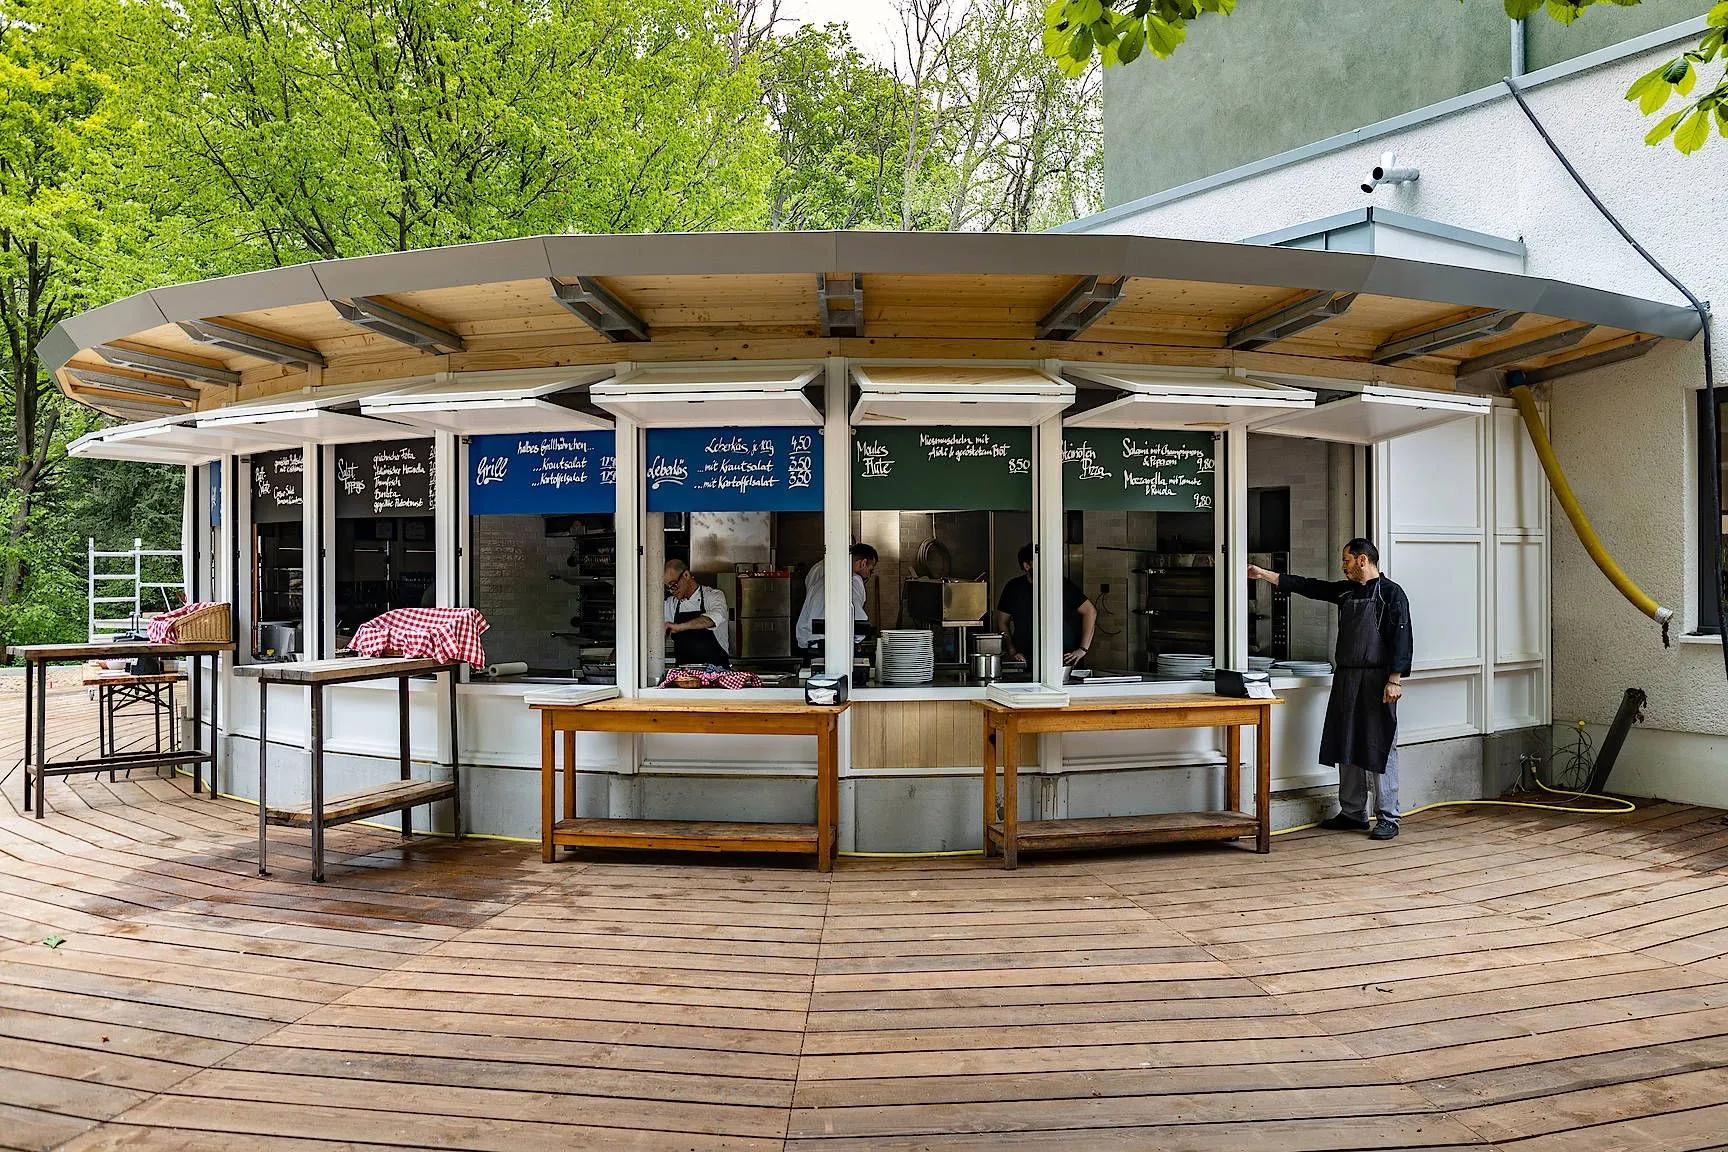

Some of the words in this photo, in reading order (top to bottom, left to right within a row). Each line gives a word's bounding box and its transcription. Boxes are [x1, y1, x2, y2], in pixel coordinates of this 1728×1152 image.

[518, 440, 539, 455] halbes
[760, 439, 775, 456] 100g
[919, 433, 974, 448] Miesmuscheln
[975, 433, 990, 445] mit
[1122, 437, 1149, 458] Salami
[1150, 444, 1161, 455] mit
[1161, 444, 1204, 460] Champignons
[856, 439, 889, 462] Moules
[992, 443, 1011, 458] Brot
[646, 455, 689, 481] Leberkäs
[719, 458, 774, 474] Krautsalat
[1008, 458, 1031, 473] 8,50
[1079, 458, 1112, 480] Pizza
[1142, 455, 1150, 467] &
[1196, 457, 1215, 473] 9,80
[477, 456, 509, 485] Grill
[718, 474, 780, 494] Kartoffelsalat
[1123, 469, 1168, 490] Mozzarella
[1168, 475, 1178, 485] mit
[1151, 484, 1177, 496] Rucola
[1193, 493, 1212, 508] 9,80
